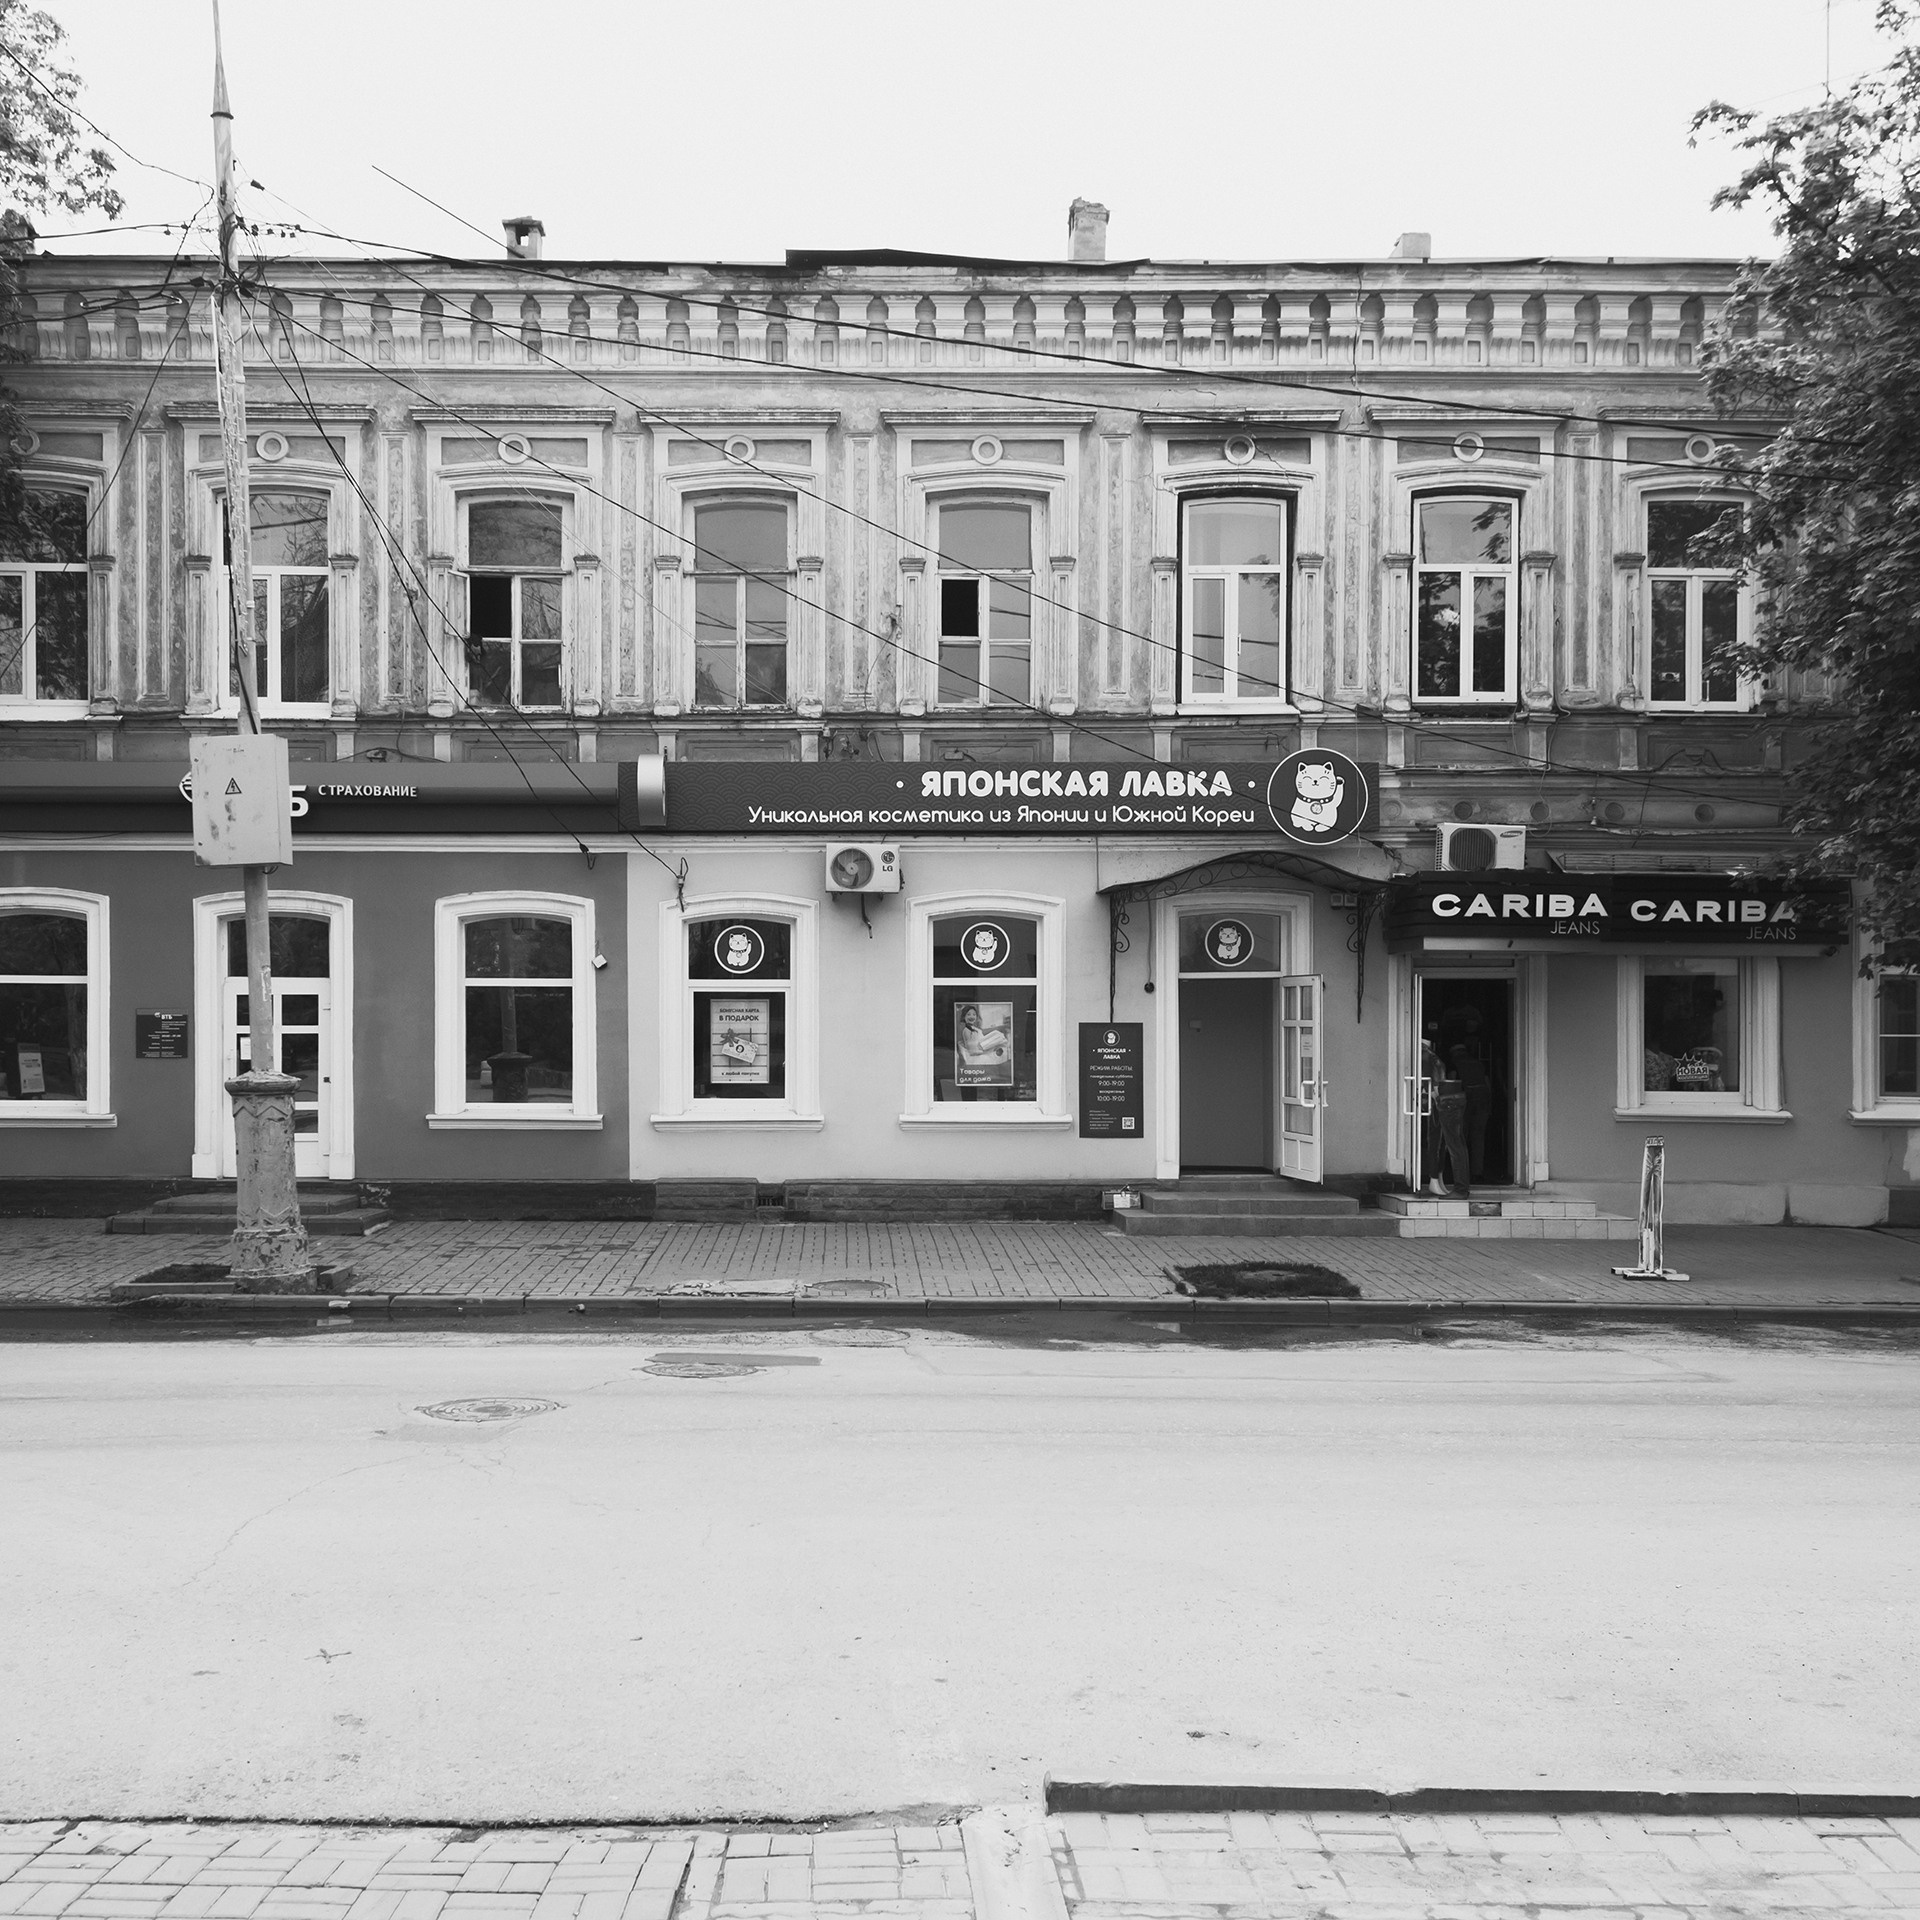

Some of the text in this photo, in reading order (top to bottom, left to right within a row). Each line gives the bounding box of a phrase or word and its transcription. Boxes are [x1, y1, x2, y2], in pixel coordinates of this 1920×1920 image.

[318, 784, 418, 797] СТРАХОВАНИЕ
[921, 770, 1233, 797] ЯПОНСКАЯ ЛАВКА
[748, 806, 1255, 827] Уникальная косметика из Японии и Южной Кореи
[1432, 893, 1609, 918] CARIBA
[1630, 899, 1800, 923] CARIBA
[1550, 920, 1600, 935] JEANS
[1746, 926, 1797, 941] JEANS
[960, 1068, 985, 1076] Товары
[1677, 1066, 1708, 1075] НОВАЯ
